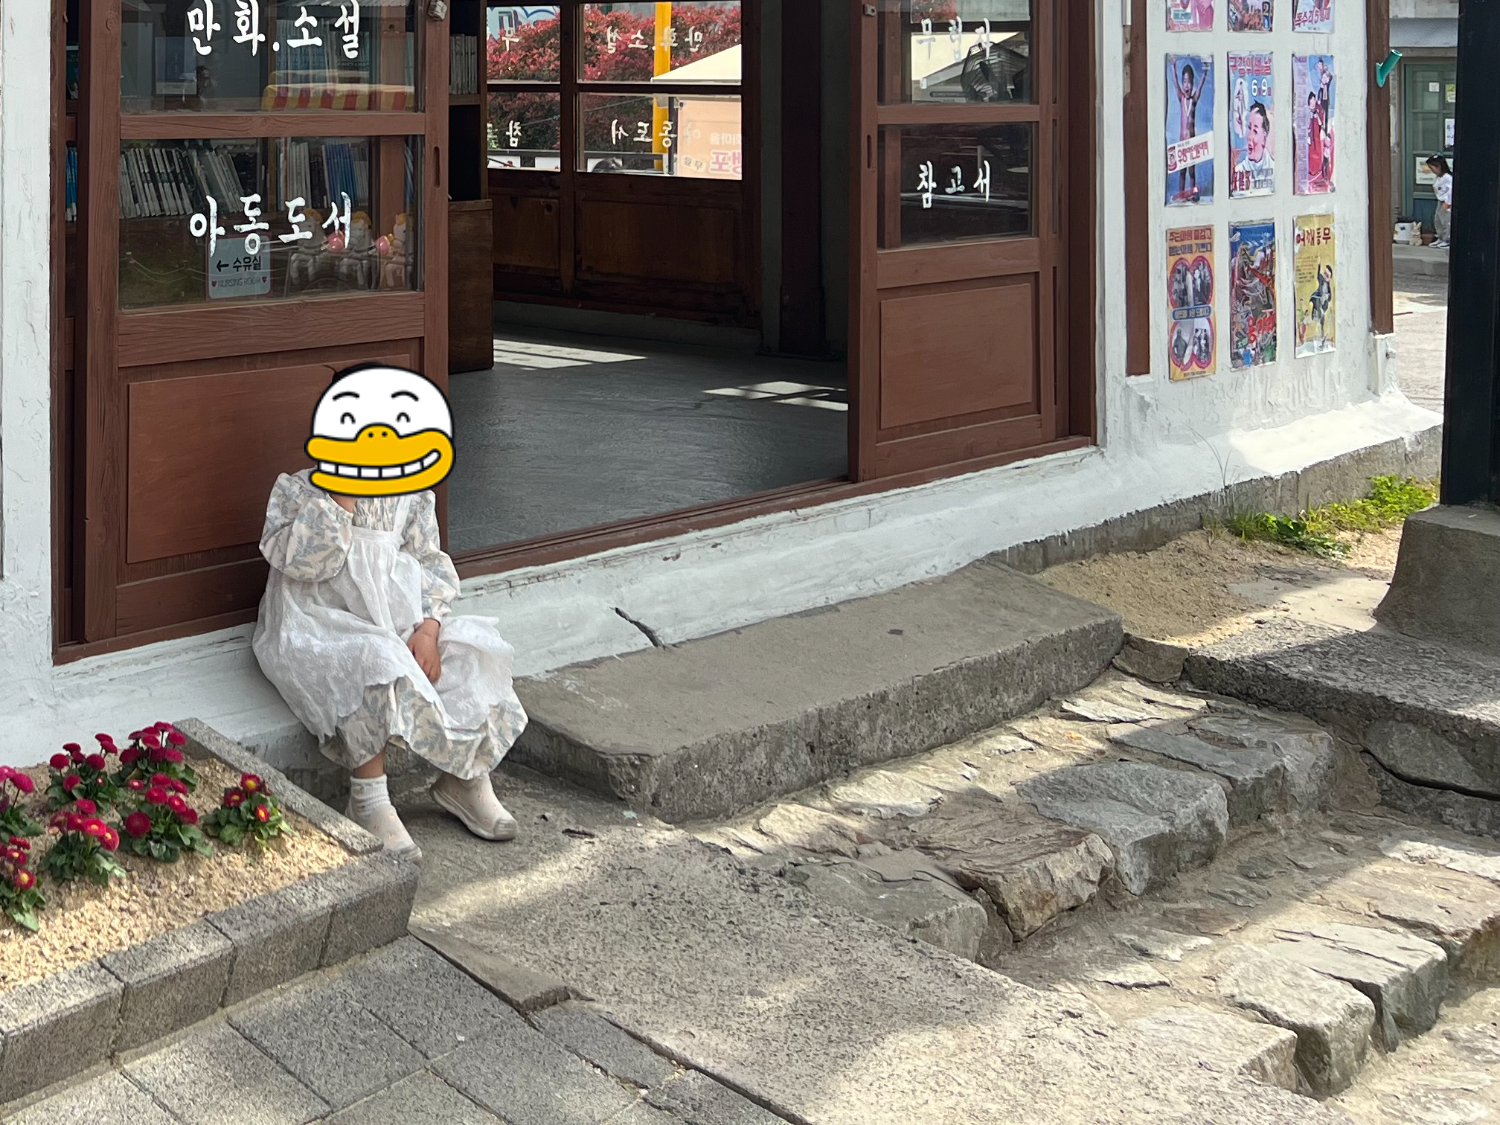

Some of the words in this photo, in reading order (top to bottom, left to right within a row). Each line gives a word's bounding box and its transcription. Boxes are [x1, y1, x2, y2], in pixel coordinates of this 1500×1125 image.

[916, 159, 991, 209] 참고서
[189, 191, 353, 257] 아동도서
[233, 256, 261, 272] 수유실
